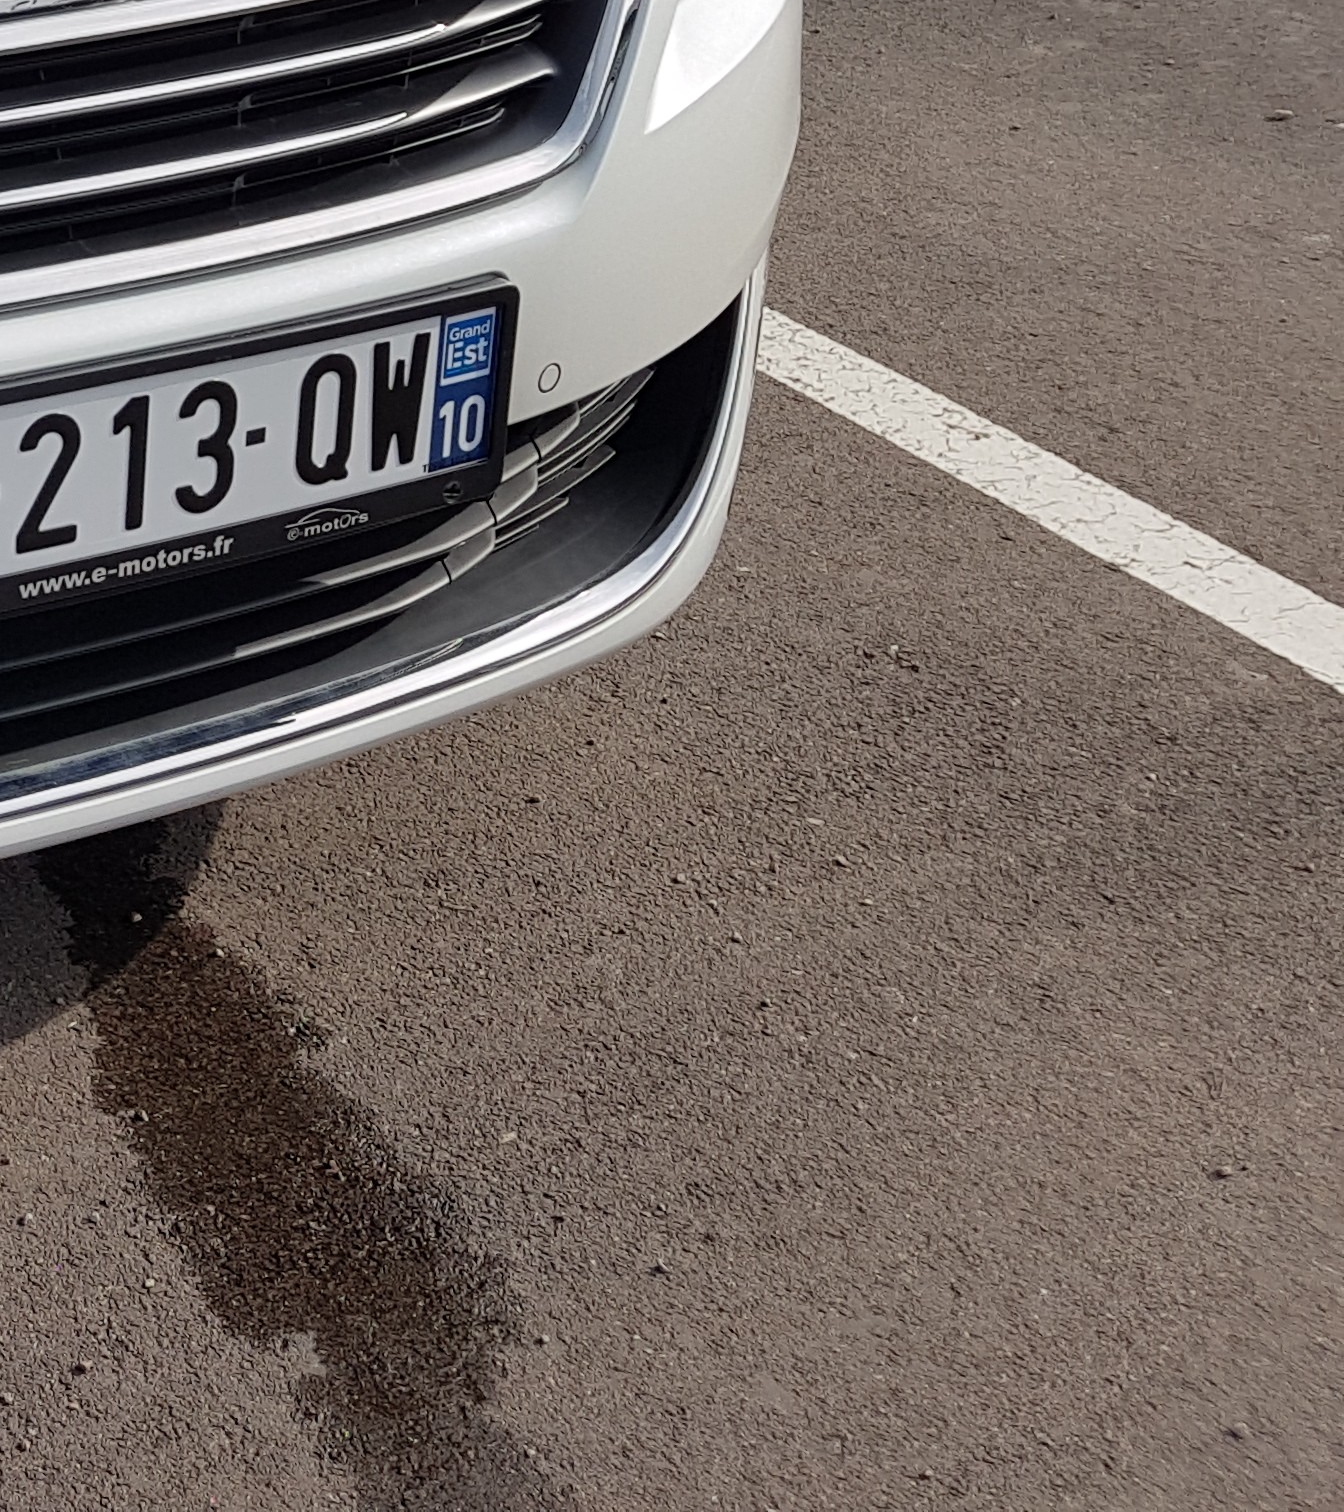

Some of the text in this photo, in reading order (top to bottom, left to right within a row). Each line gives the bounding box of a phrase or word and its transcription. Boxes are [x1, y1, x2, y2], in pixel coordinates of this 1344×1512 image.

[446, 337, 489, 370] Est
[449, 319, 490, 340] Grand
[439, 394, 486, 458] 10
[19, 535, 234, 600] www.e-motors.fr
